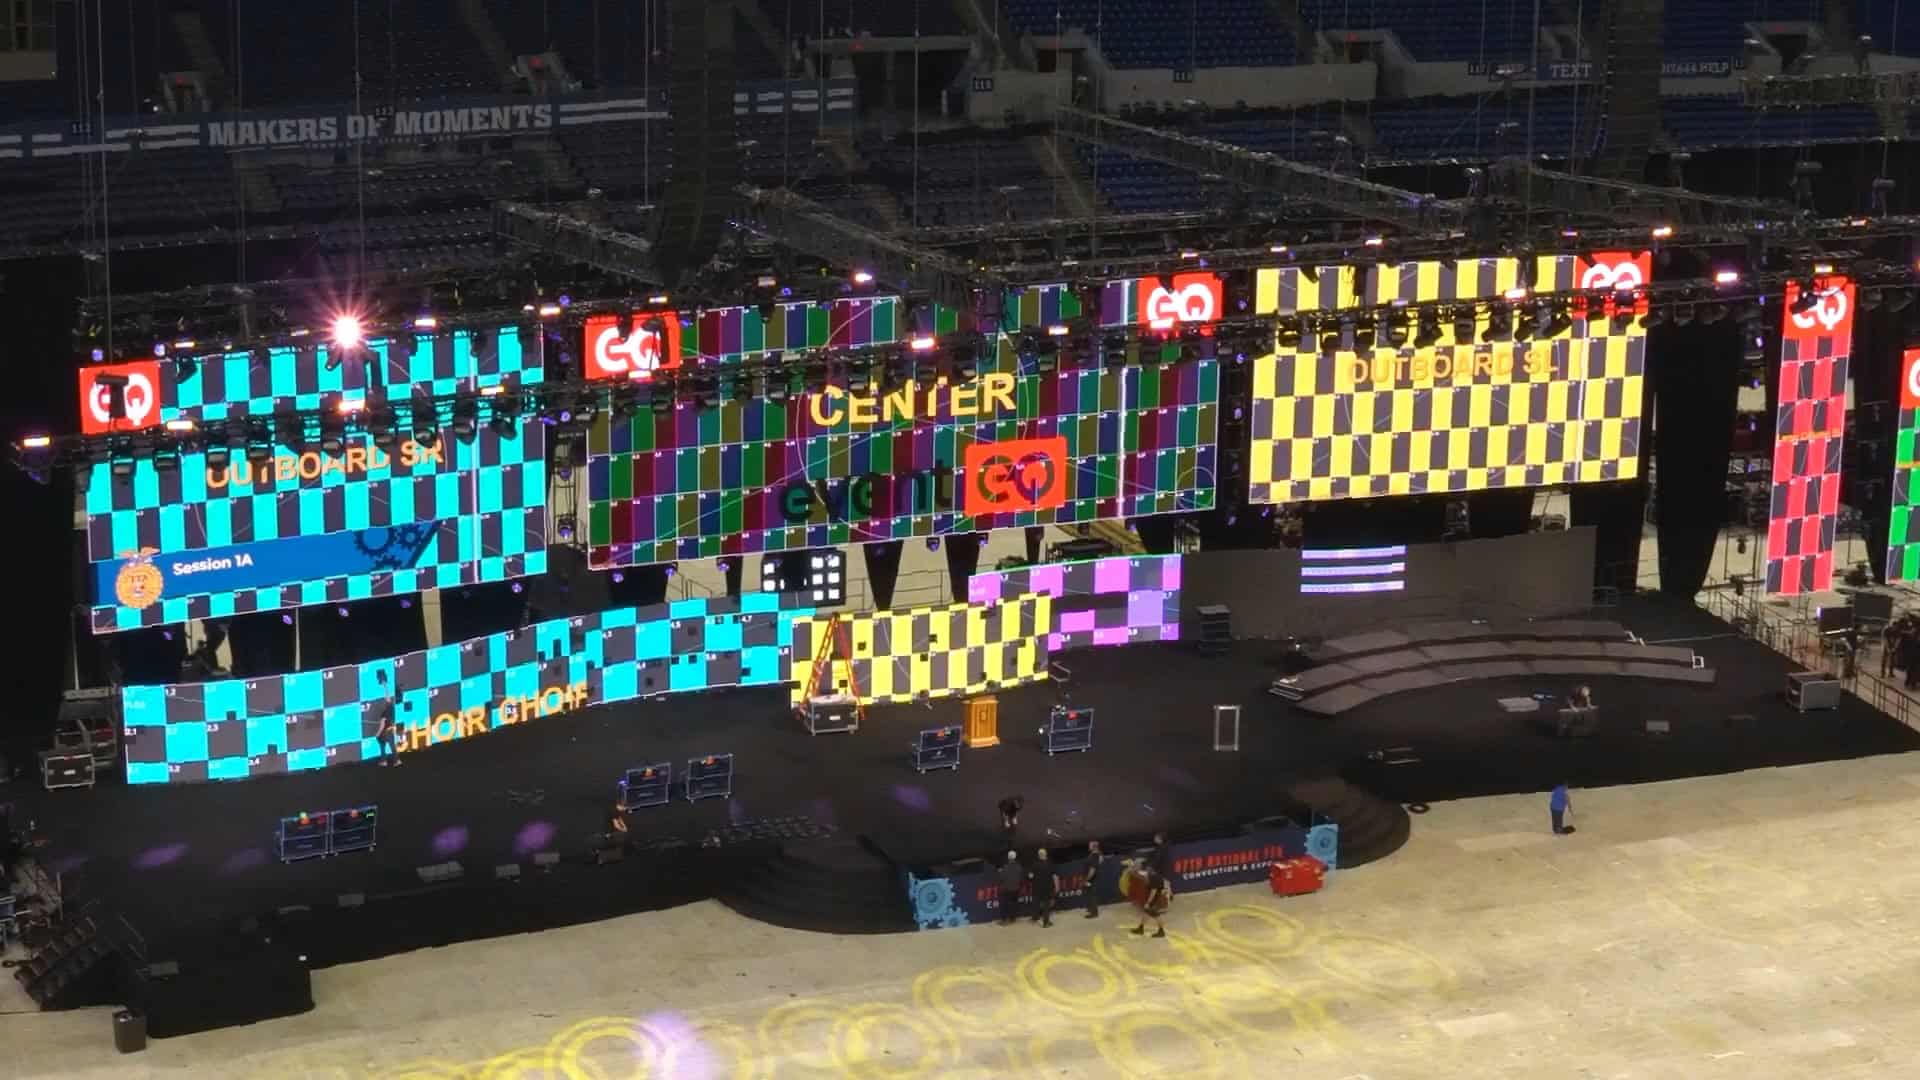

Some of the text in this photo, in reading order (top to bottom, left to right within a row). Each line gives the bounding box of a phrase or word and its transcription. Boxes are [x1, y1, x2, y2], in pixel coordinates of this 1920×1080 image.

[1551, 63, 1593, 79] TEXT
[208, 117, 338, 147] MAKERS
[346, 112, 382, 139] OF
[394, 103, 553, 136] MOMENTS
[1348, 347, 1560, 384] OUTBOARD SL
[809, 372, 1018, 427] CENTER
[206, 444, 392, 489] OUTBOARD
[172, 552, 255, 576] Session 1A
[1182, 862, 1240, 881] CONVENTION
